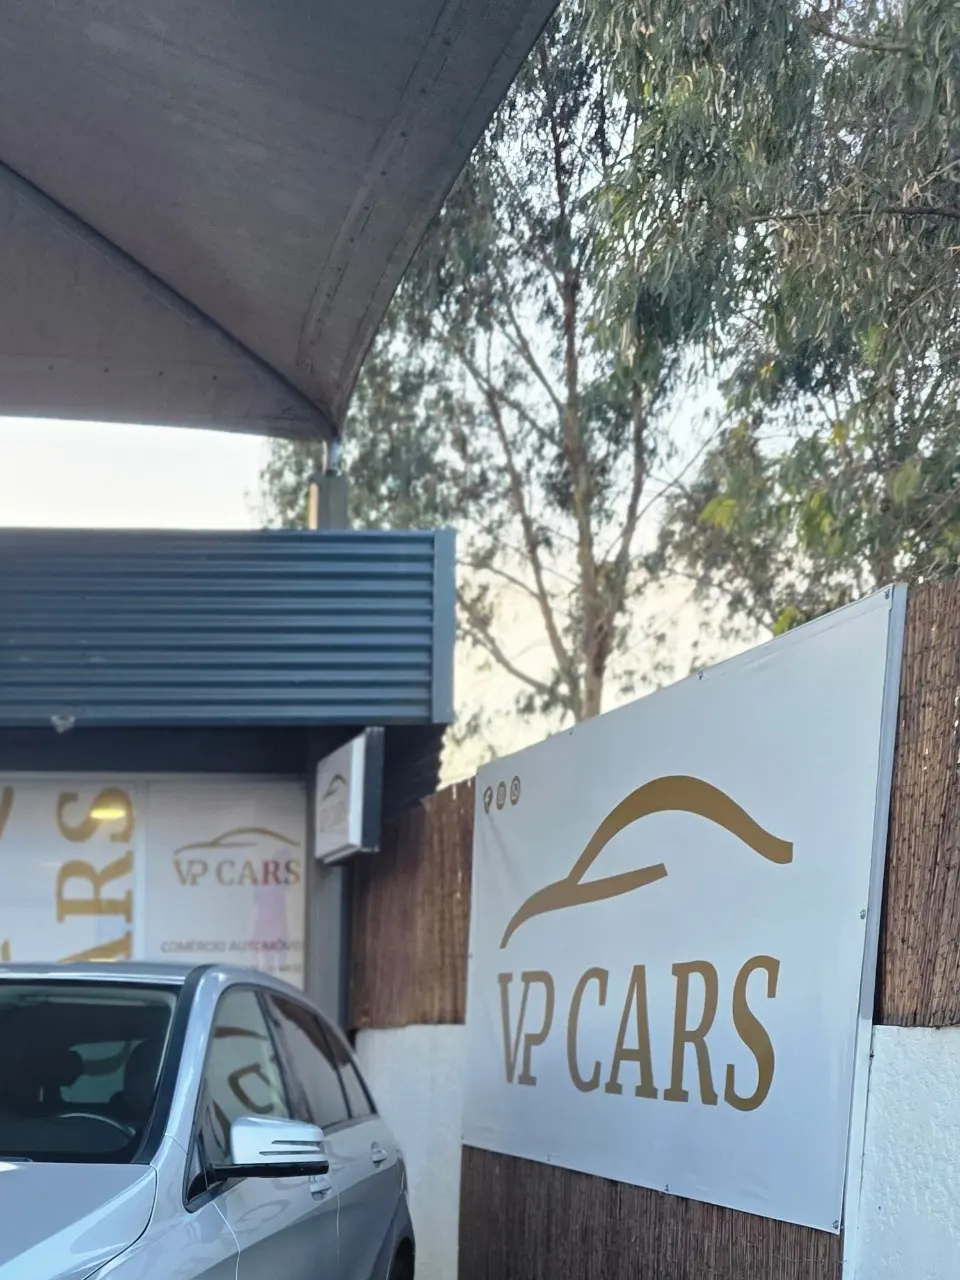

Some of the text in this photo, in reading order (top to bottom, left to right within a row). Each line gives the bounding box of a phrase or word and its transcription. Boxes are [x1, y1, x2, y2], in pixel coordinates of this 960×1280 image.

[173, 858, 301, 887] VP CARS
[497, 955, 780, 1112] VP CARS
